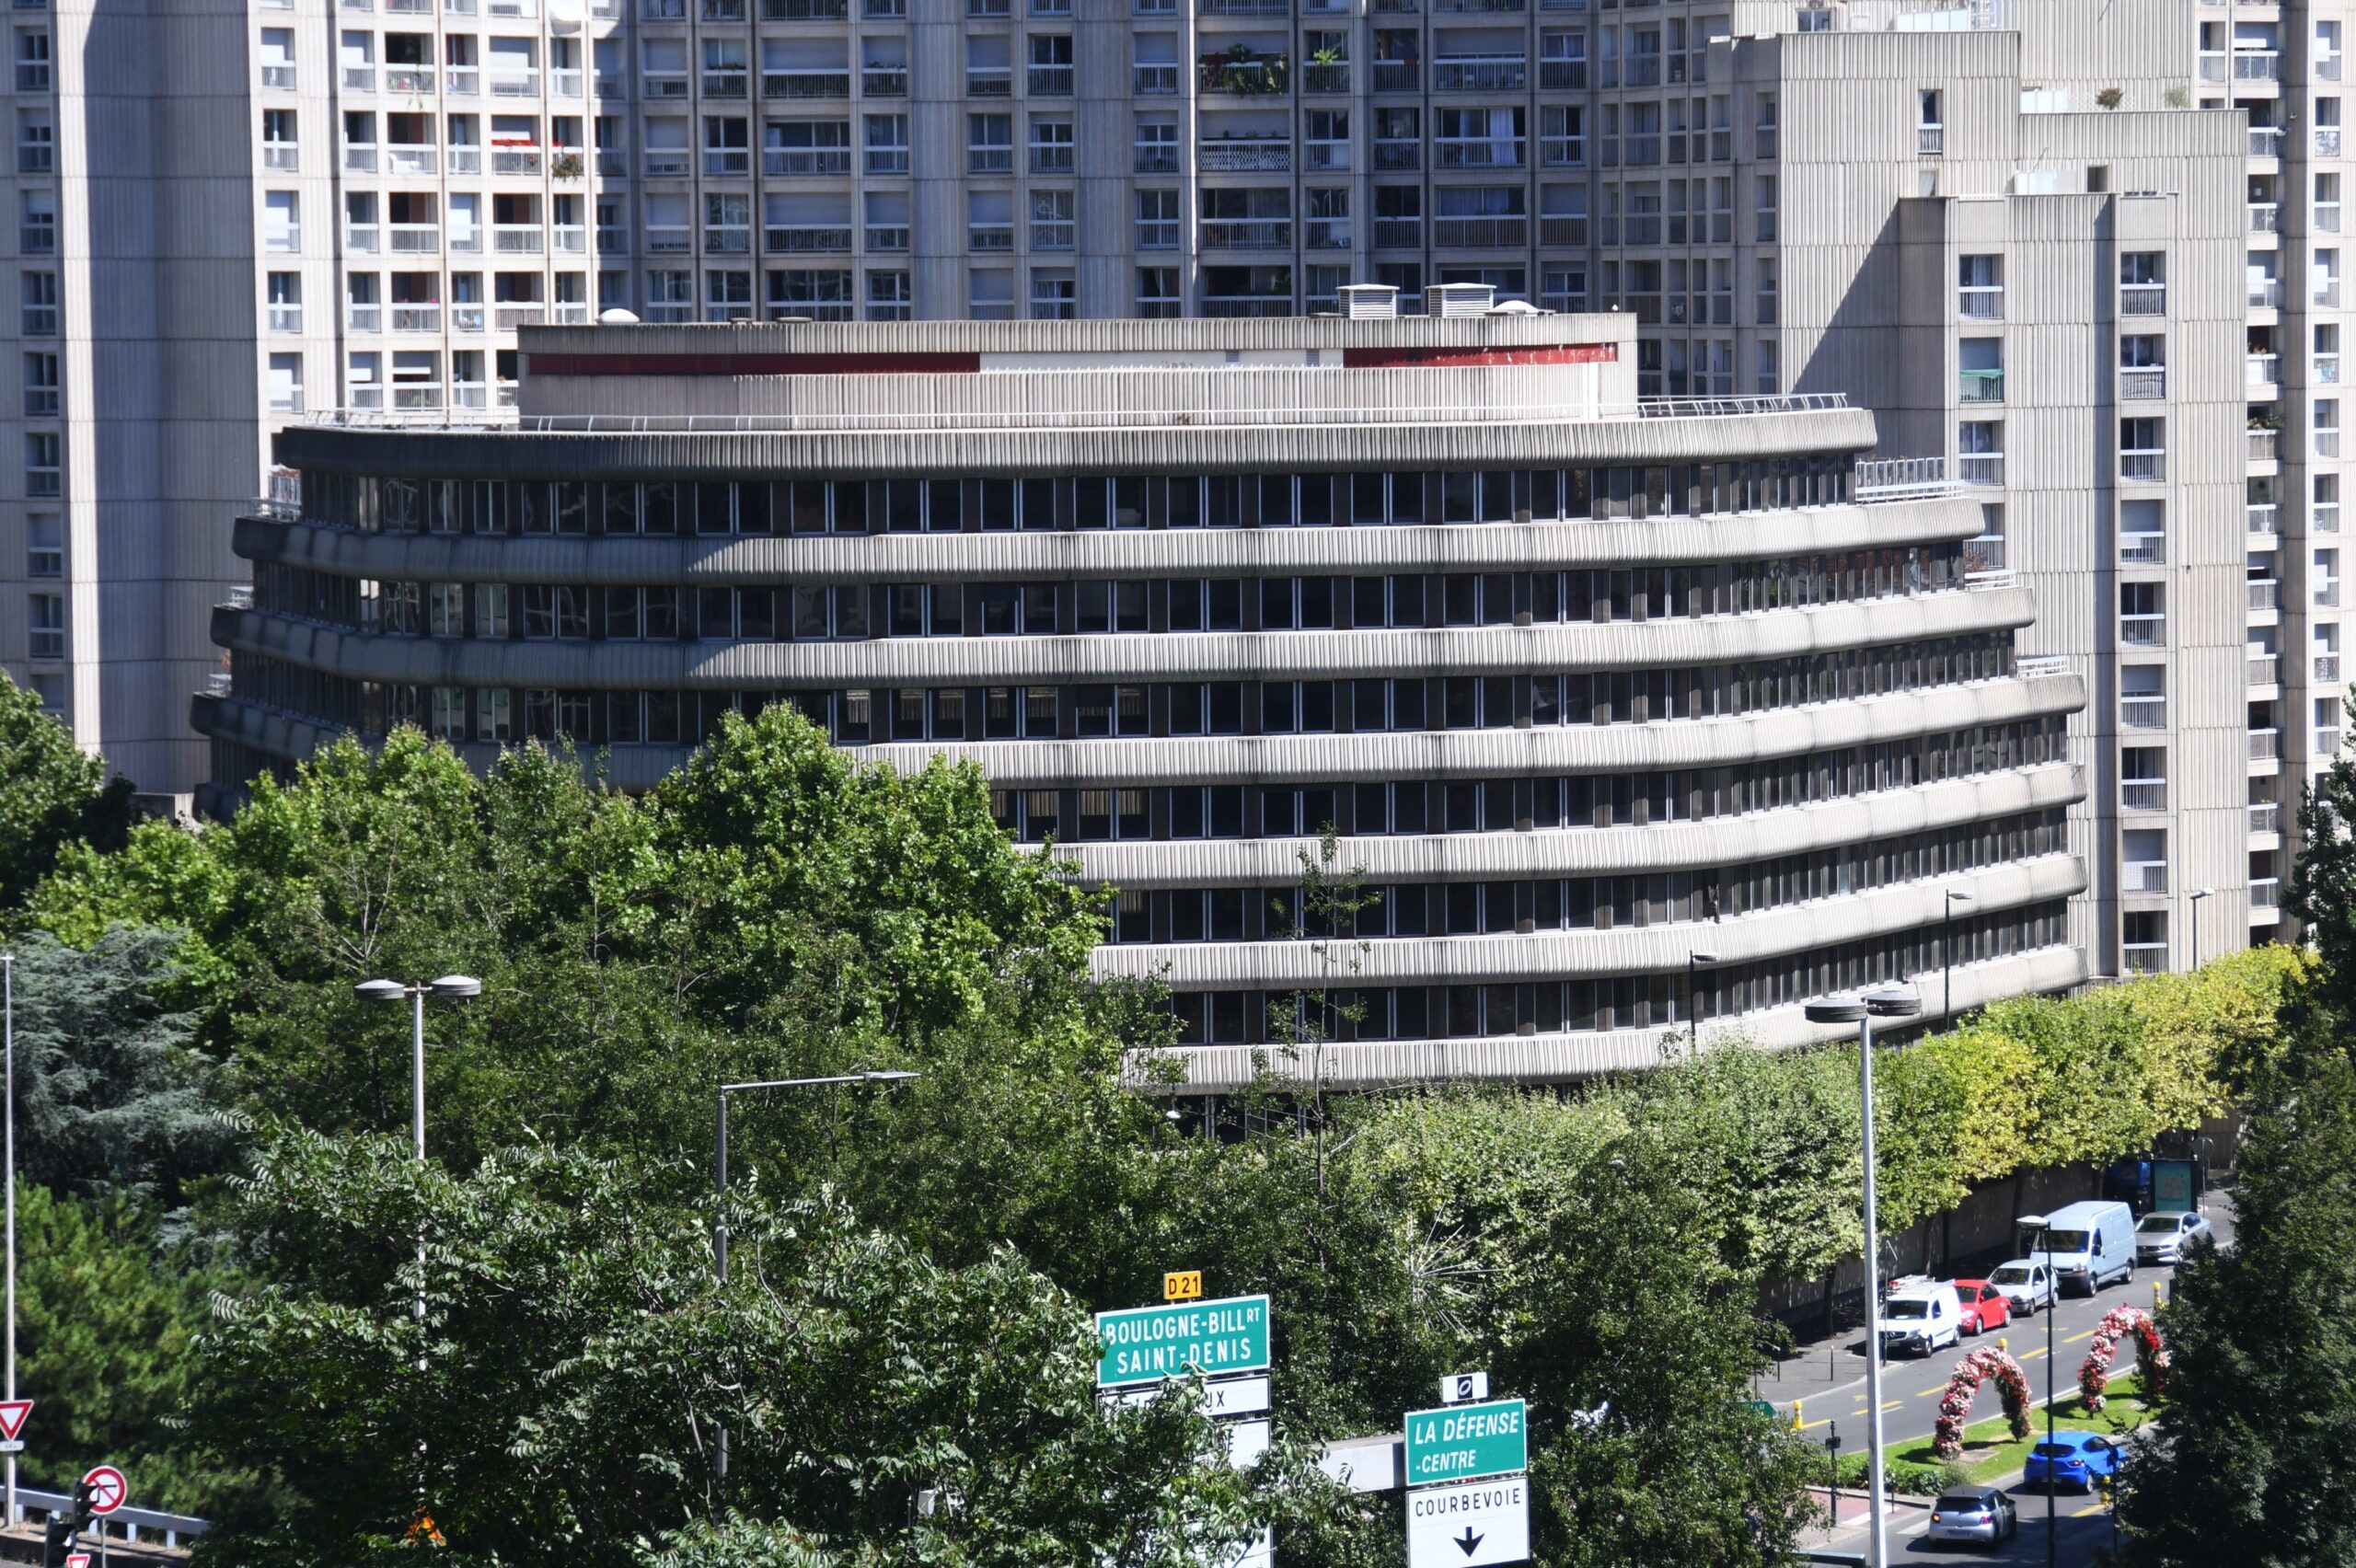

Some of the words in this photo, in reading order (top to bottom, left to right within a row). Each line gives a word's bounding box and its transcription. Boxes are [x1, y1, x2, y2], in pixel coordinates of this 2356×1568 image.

[1116, 1337, 1252, 1375] SAINT-DENIS
[1415, 1421, 1437, 1445] LA
[1442, 1412, 1520, 1442] DÉFENSE
[1415, 1487, 1520, 1517] COURBEVOIE
